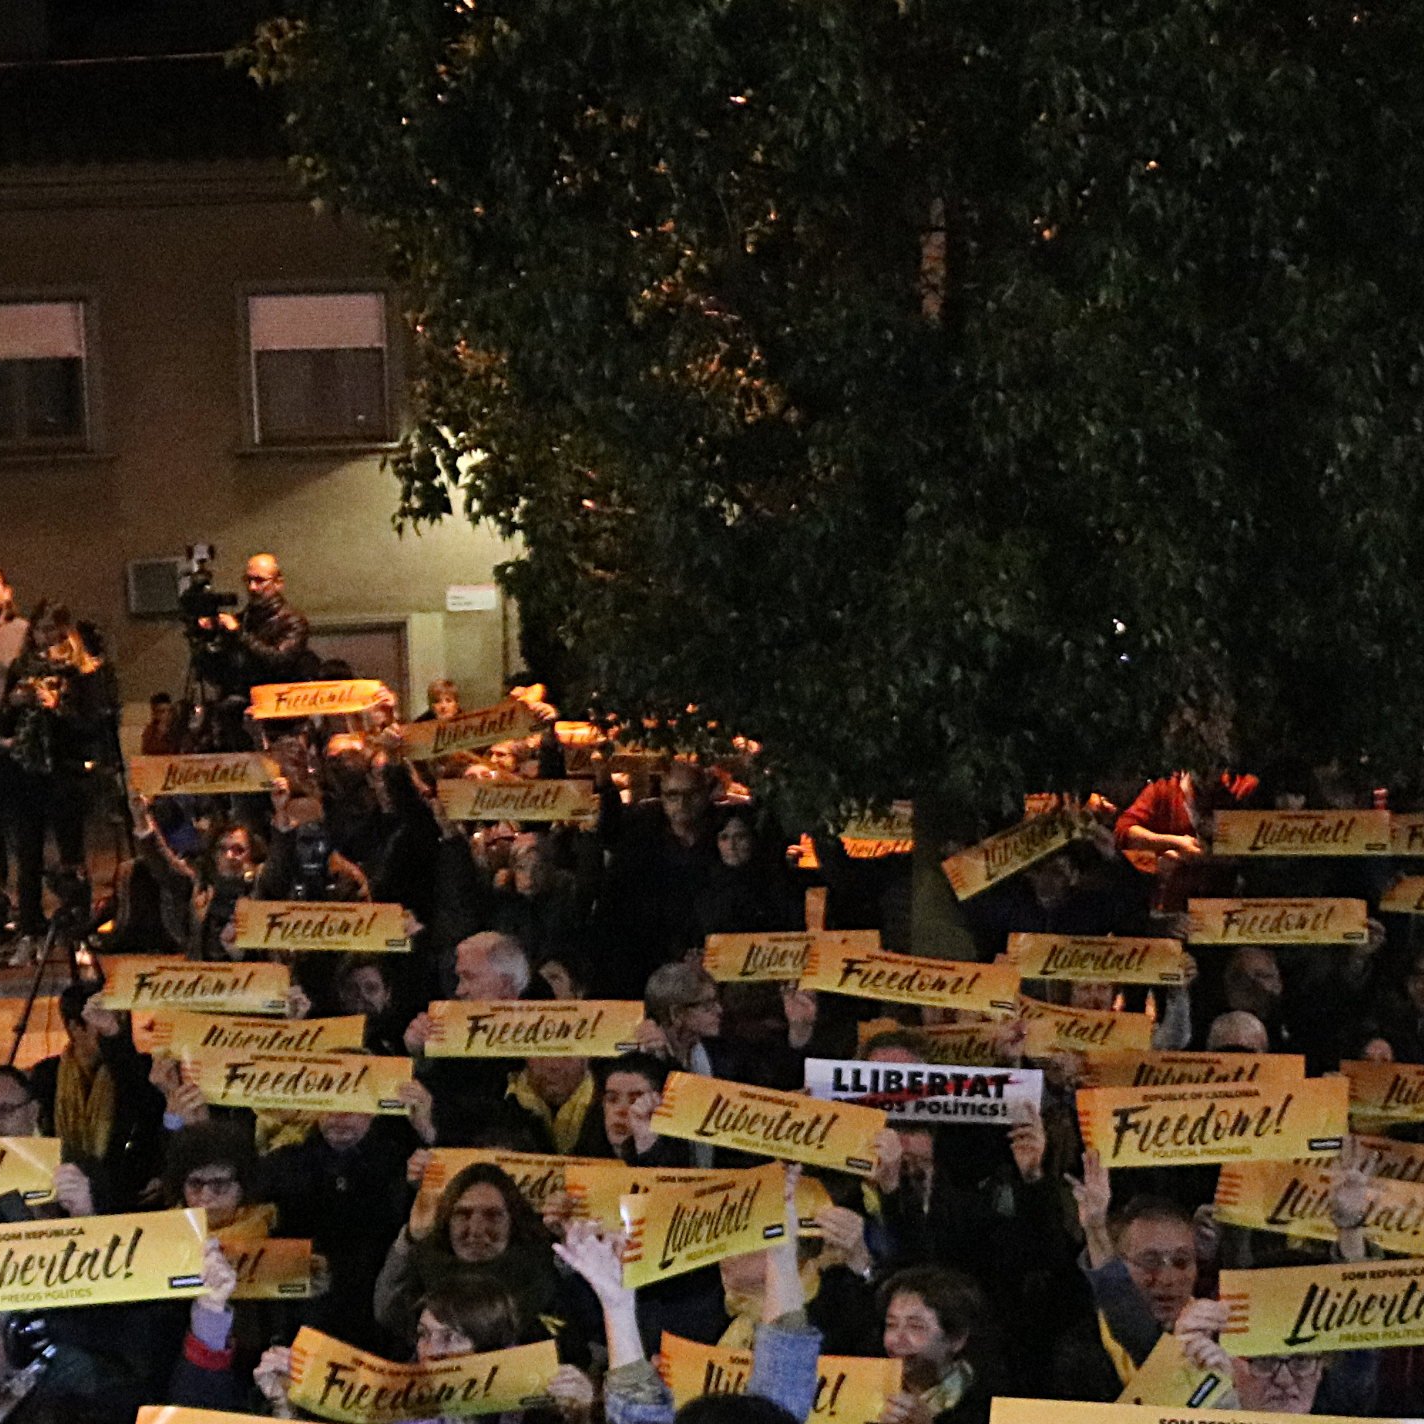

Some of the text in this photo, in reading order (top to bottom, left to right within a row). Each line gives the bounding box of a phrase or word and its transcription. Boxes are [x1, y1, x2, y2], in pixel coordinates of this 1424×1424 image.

[1250, 818, 1352, 851] Llibertat!
[265, 911, 375, 941] Freedom!
[1223, 906, 1331, 938] Freedom!
[840, 958, 977, 995] Freedom!
[1044, 942, 1145, 974] Llibertat!
[132, 970, 254, 1003] Freedom!
[467, 1011, 601, 1049] Freedom!
[223, 1059, 365, 1103] Freedom!
[832, 1066, 1012, 1099] LLIBERTAT
[696, 1091, 838, 1150] Llibertat!
[1112, 1093, 1284, 1157] Freedom!
[662, 1181, 760, 1269] Llibertat!
[320, 1356, 498, 1413] Freedom!
